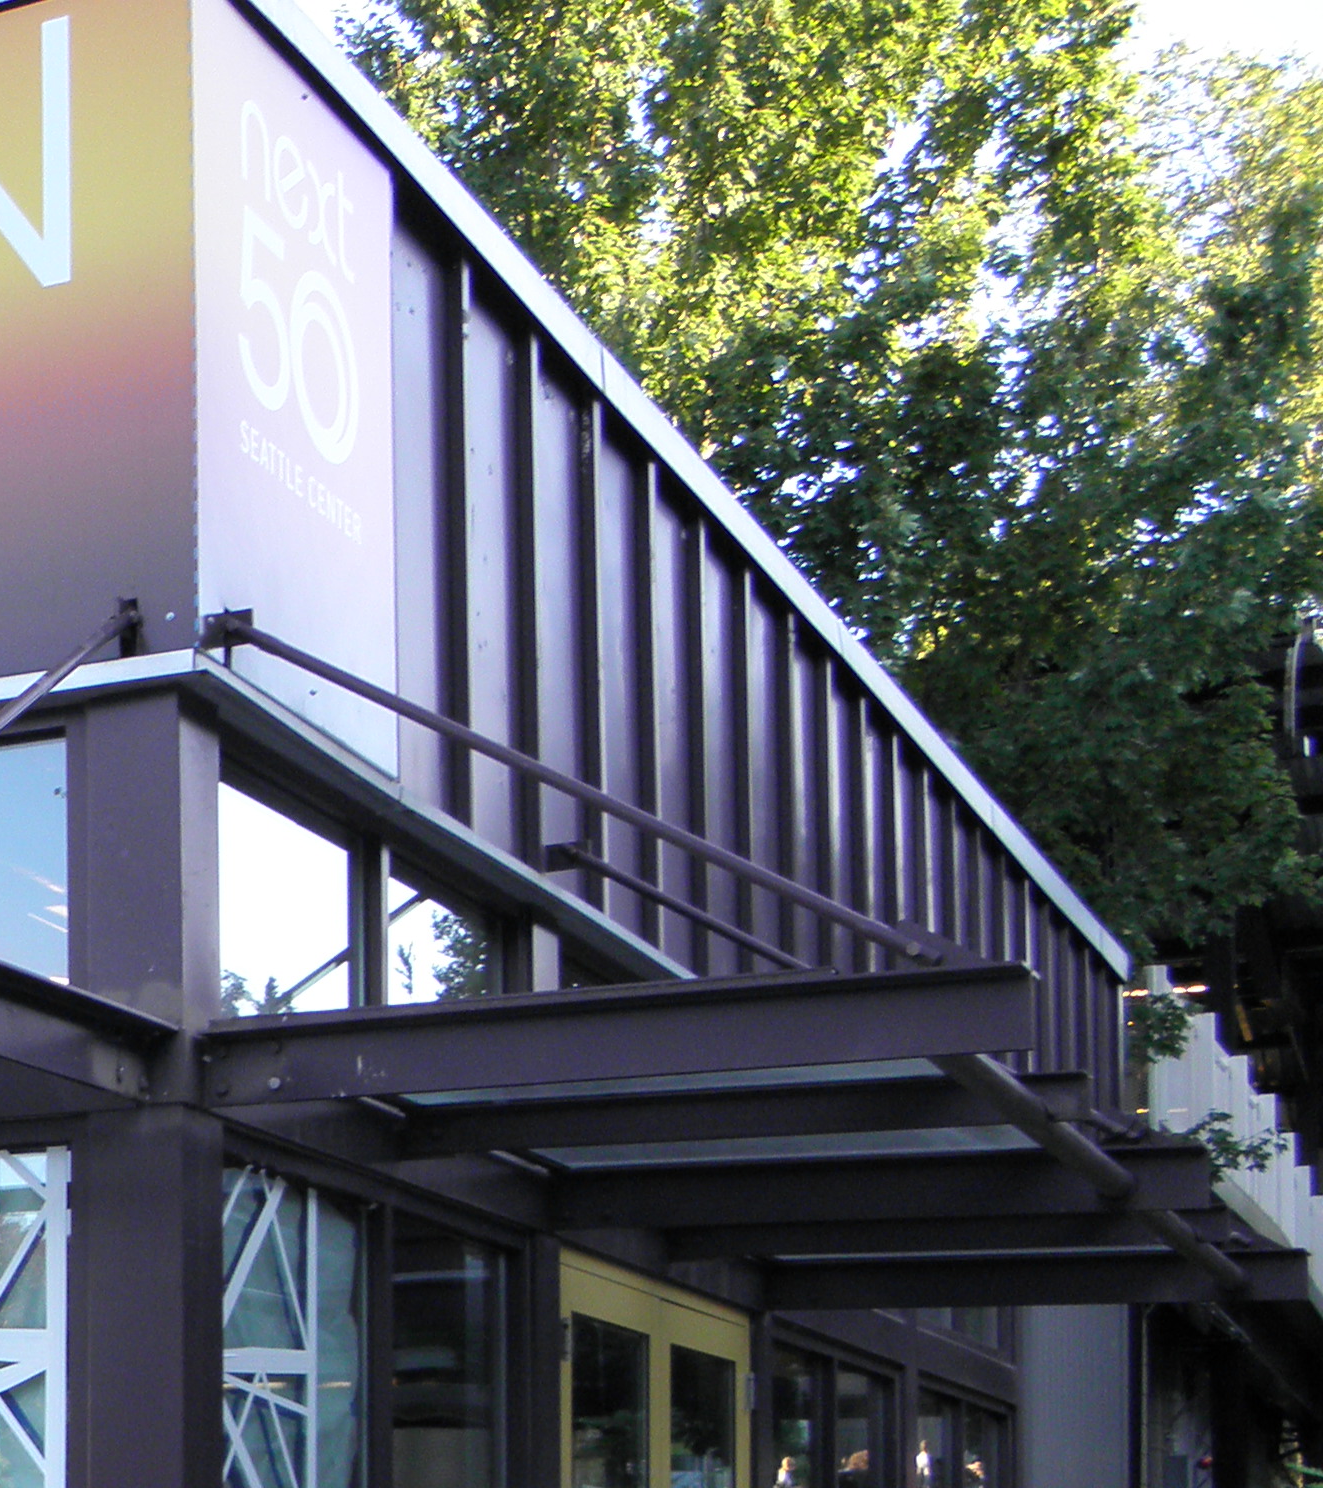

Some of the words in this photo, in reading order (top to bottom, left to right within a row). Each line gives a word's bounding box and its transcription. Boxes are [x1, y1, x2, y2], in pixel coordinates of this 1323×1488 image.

[240, 100, 356, 285] next
[238, 204, 359, 465] 50
[239, 420, 304, 497] SEATTLE
[307, 476, 362, 545] CENTER
